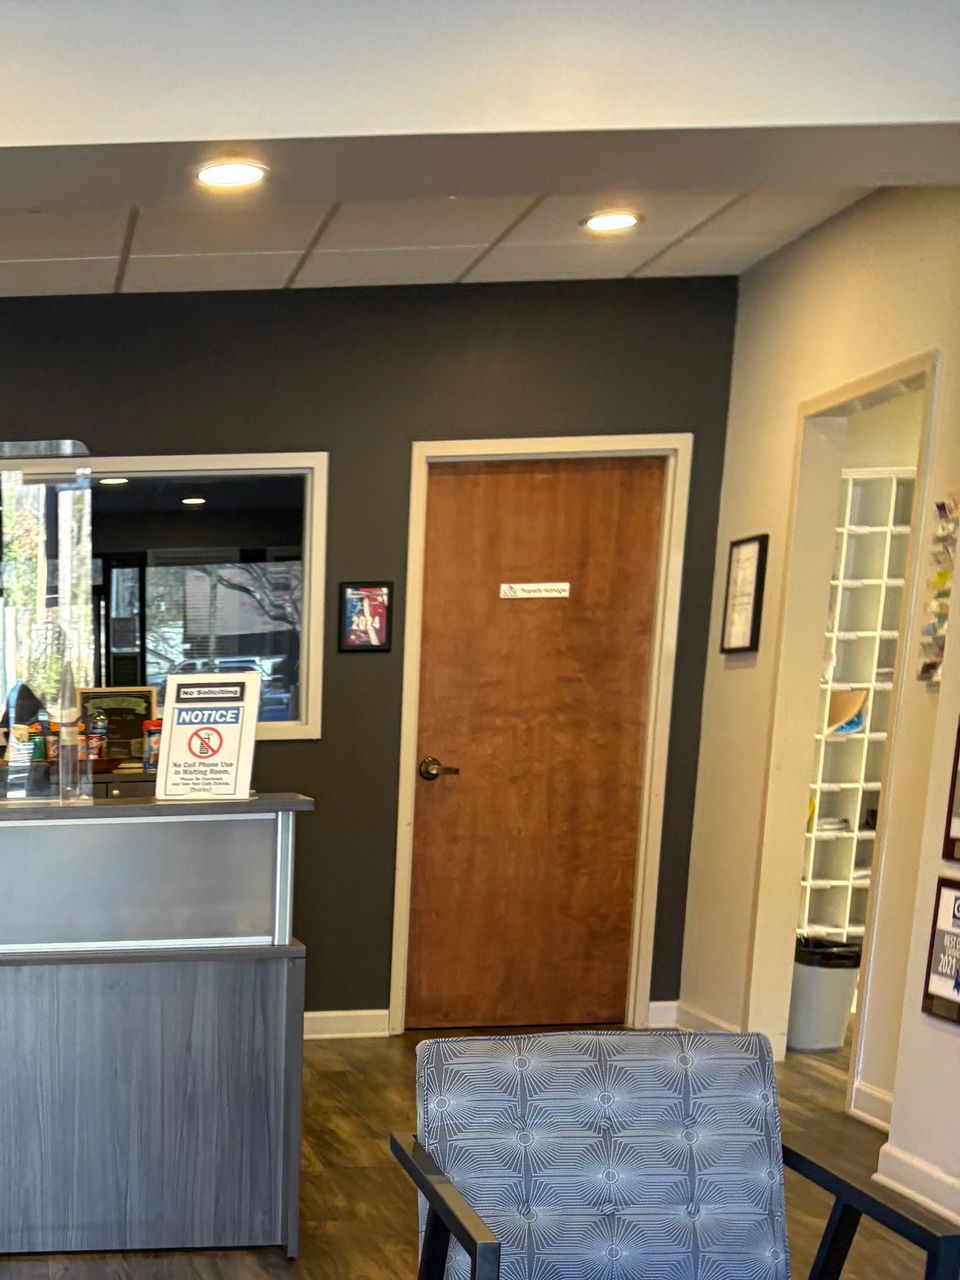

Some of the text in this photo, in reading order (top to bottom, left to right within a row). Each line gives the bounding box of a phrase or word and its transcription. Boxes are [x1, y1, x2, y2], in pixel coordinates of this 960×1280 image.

[179, 710, 238, 723] NOTICE
[182, 768, 208, 776] Waiting
[938, 952, 956, 976] 2021
